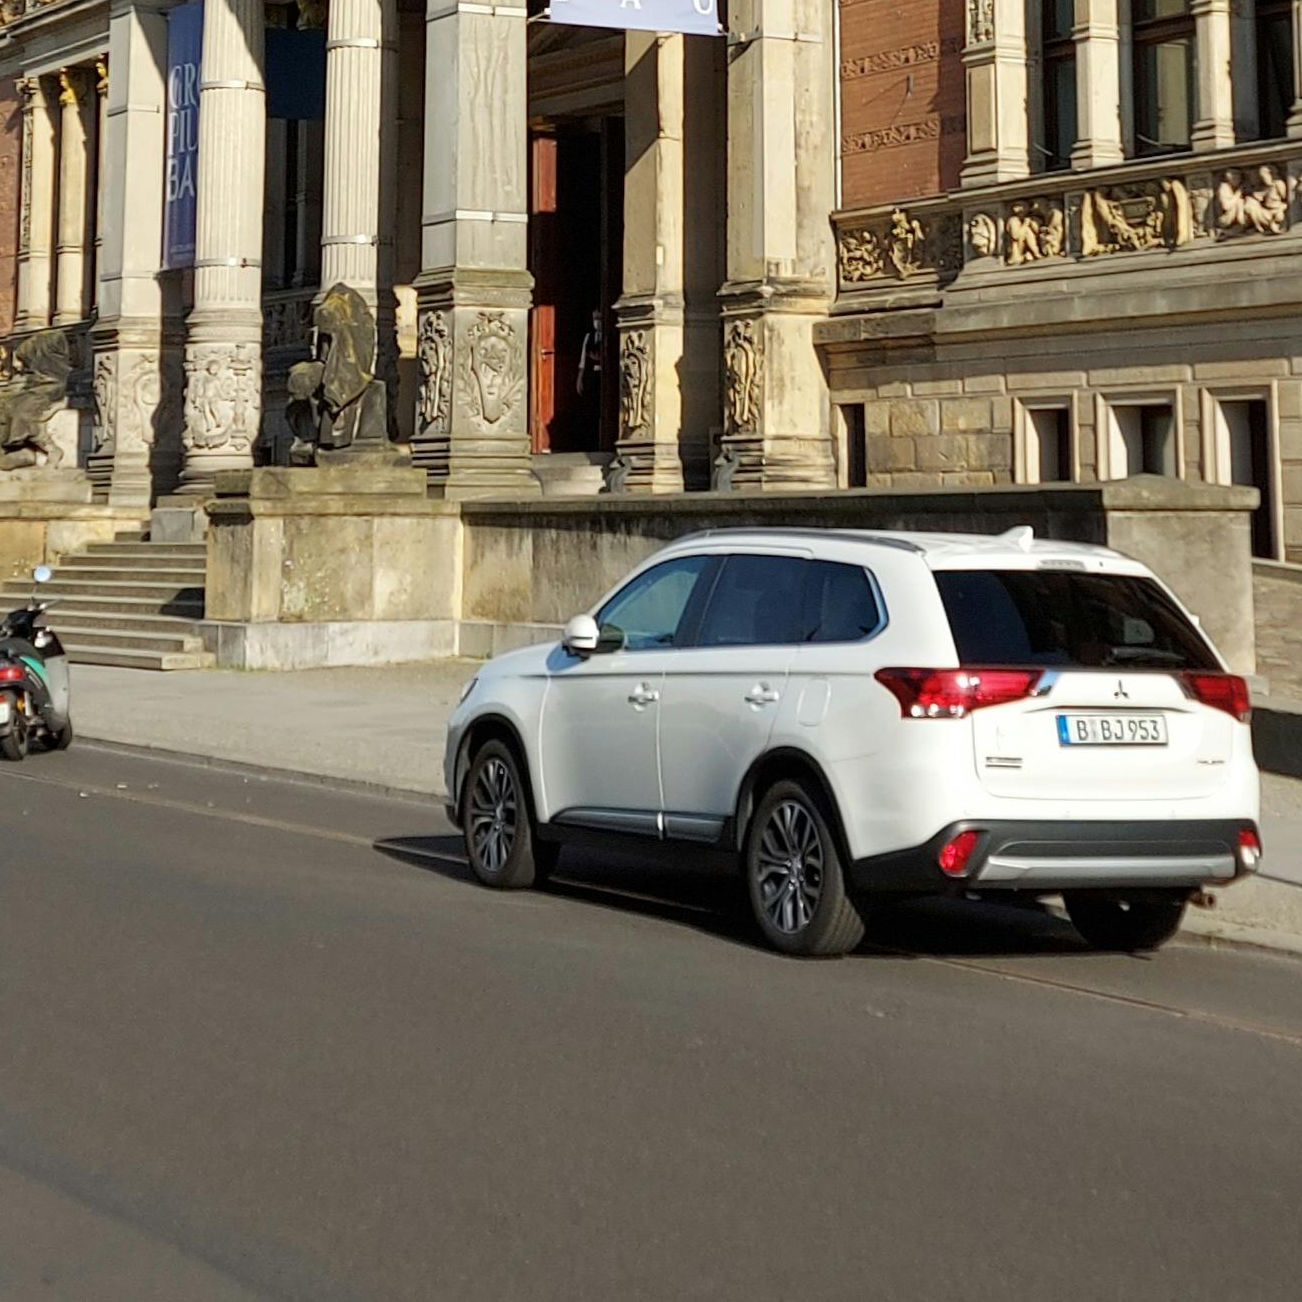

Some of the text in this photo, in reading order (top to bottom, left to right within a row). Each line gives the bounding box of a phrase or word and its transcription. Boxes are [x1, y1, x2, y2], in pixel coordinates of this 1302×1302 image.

[169, 62, 201, 109] GR
[1077, 720, 1089, 741] B
[1128, 720, 1160, 741] 953
